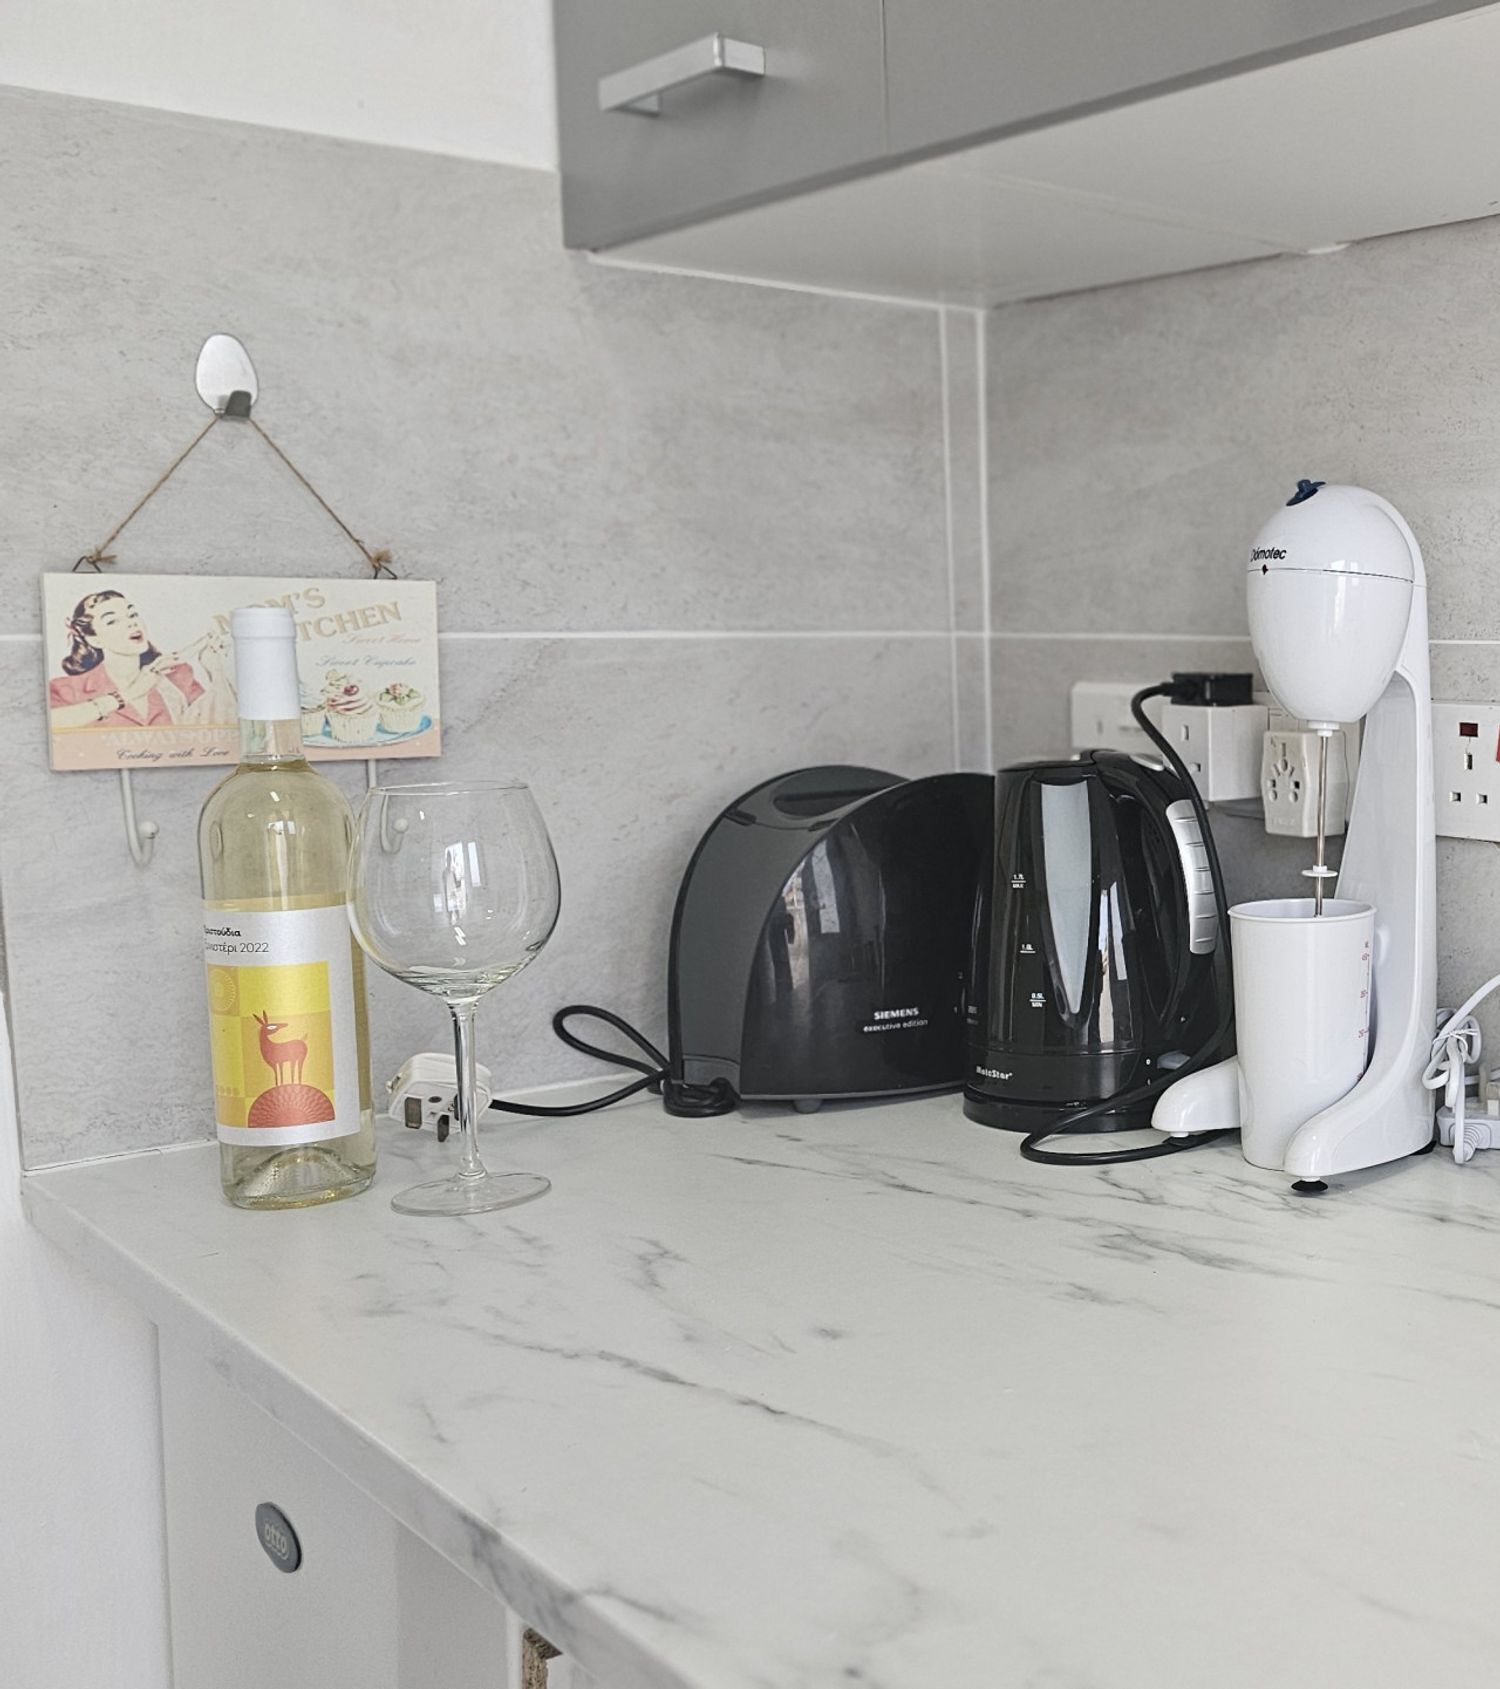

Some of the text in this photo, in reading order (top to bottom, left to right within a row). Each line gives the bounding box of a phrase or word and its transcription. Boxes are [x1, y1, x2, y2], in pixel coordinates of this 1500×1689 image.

[197, 728, 240, 743] OPE
[240, 942, 269, 953] 2022
[873, 1006, 920, 1021] SIEMENS
[863, 1019, 929, 1033] executive edition
